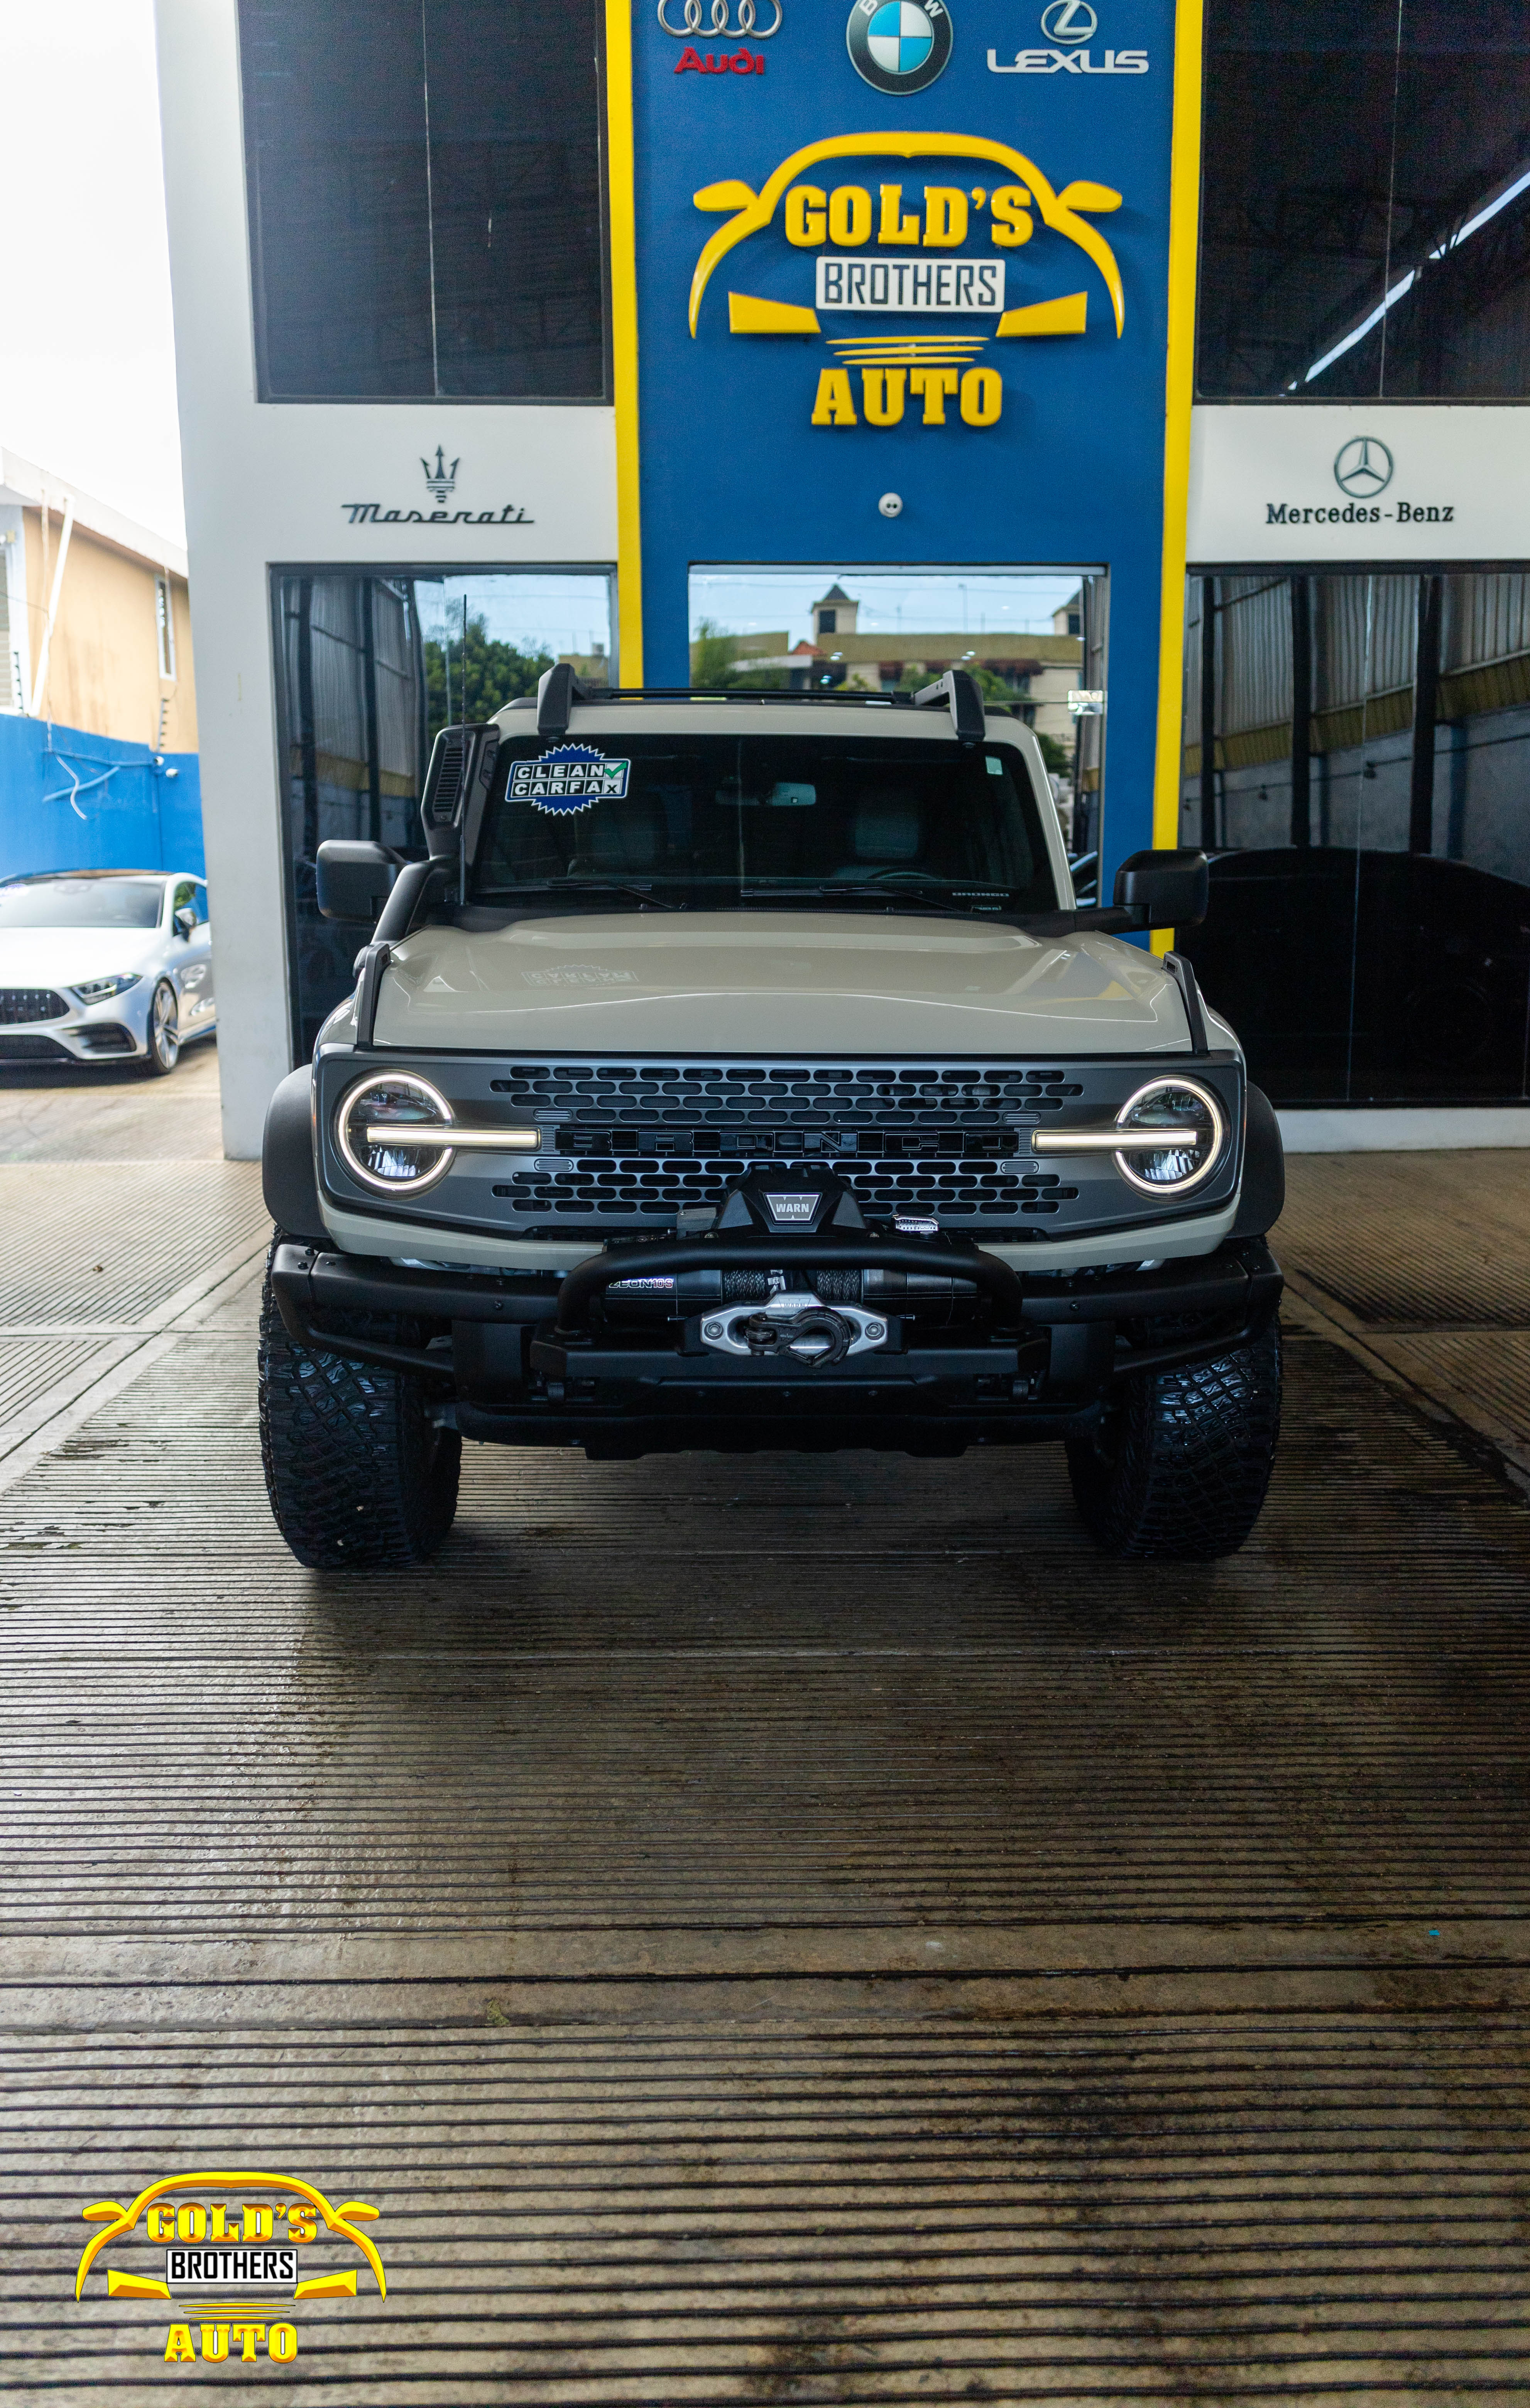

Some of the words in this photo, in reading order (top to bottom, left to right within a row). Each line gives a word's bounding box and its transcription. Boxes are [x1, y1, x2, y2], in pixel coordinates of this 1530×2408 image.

[674, 47, 764, 74] Audi
[987, 49, 1149, 74] LEXUS
[785, 184, 1033, 247] GOLD'S
[823, 262, 997, 307] BROTHERS
[811, 367, 1003, 427] AUTO
[341, 504, 535, 524] Maserati
[1266, 502, 1454, 524] Mercedes-Benz
[517, 765, 604, 778] CLEAN
[515, 781, 617, 795] CARFAX
[556, 1129, 1019, 1153] BRONCO
[776, 1203, 809, 1213] WARN
